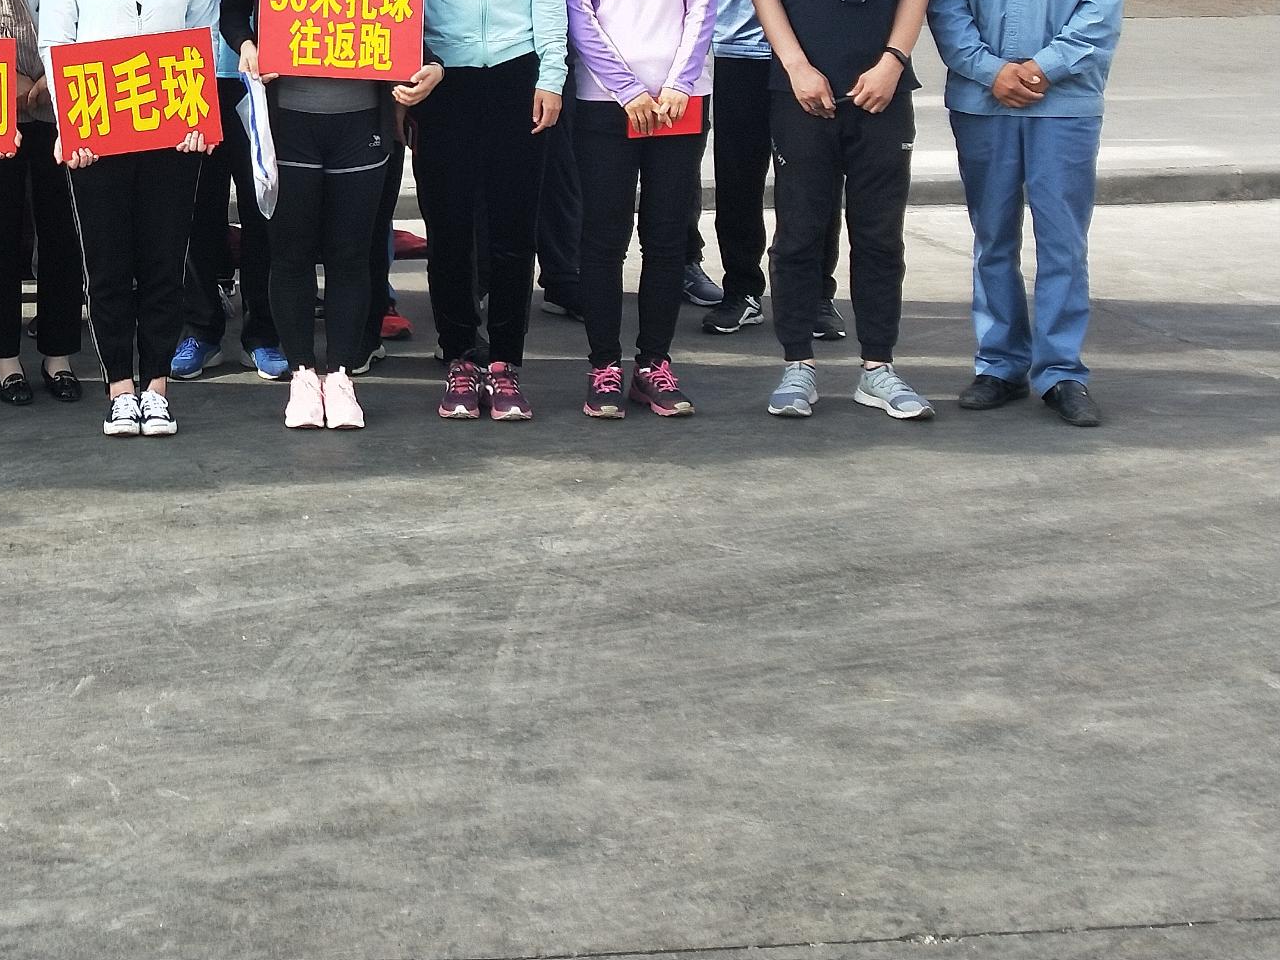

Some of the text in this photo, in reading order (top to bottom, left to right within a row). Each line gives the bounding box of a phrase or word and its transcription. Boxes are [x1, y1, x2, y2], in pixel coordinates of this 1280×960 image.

[289, 21, 392, 71] 往返跑
[62, 46, 210, 139] 羽毛球
